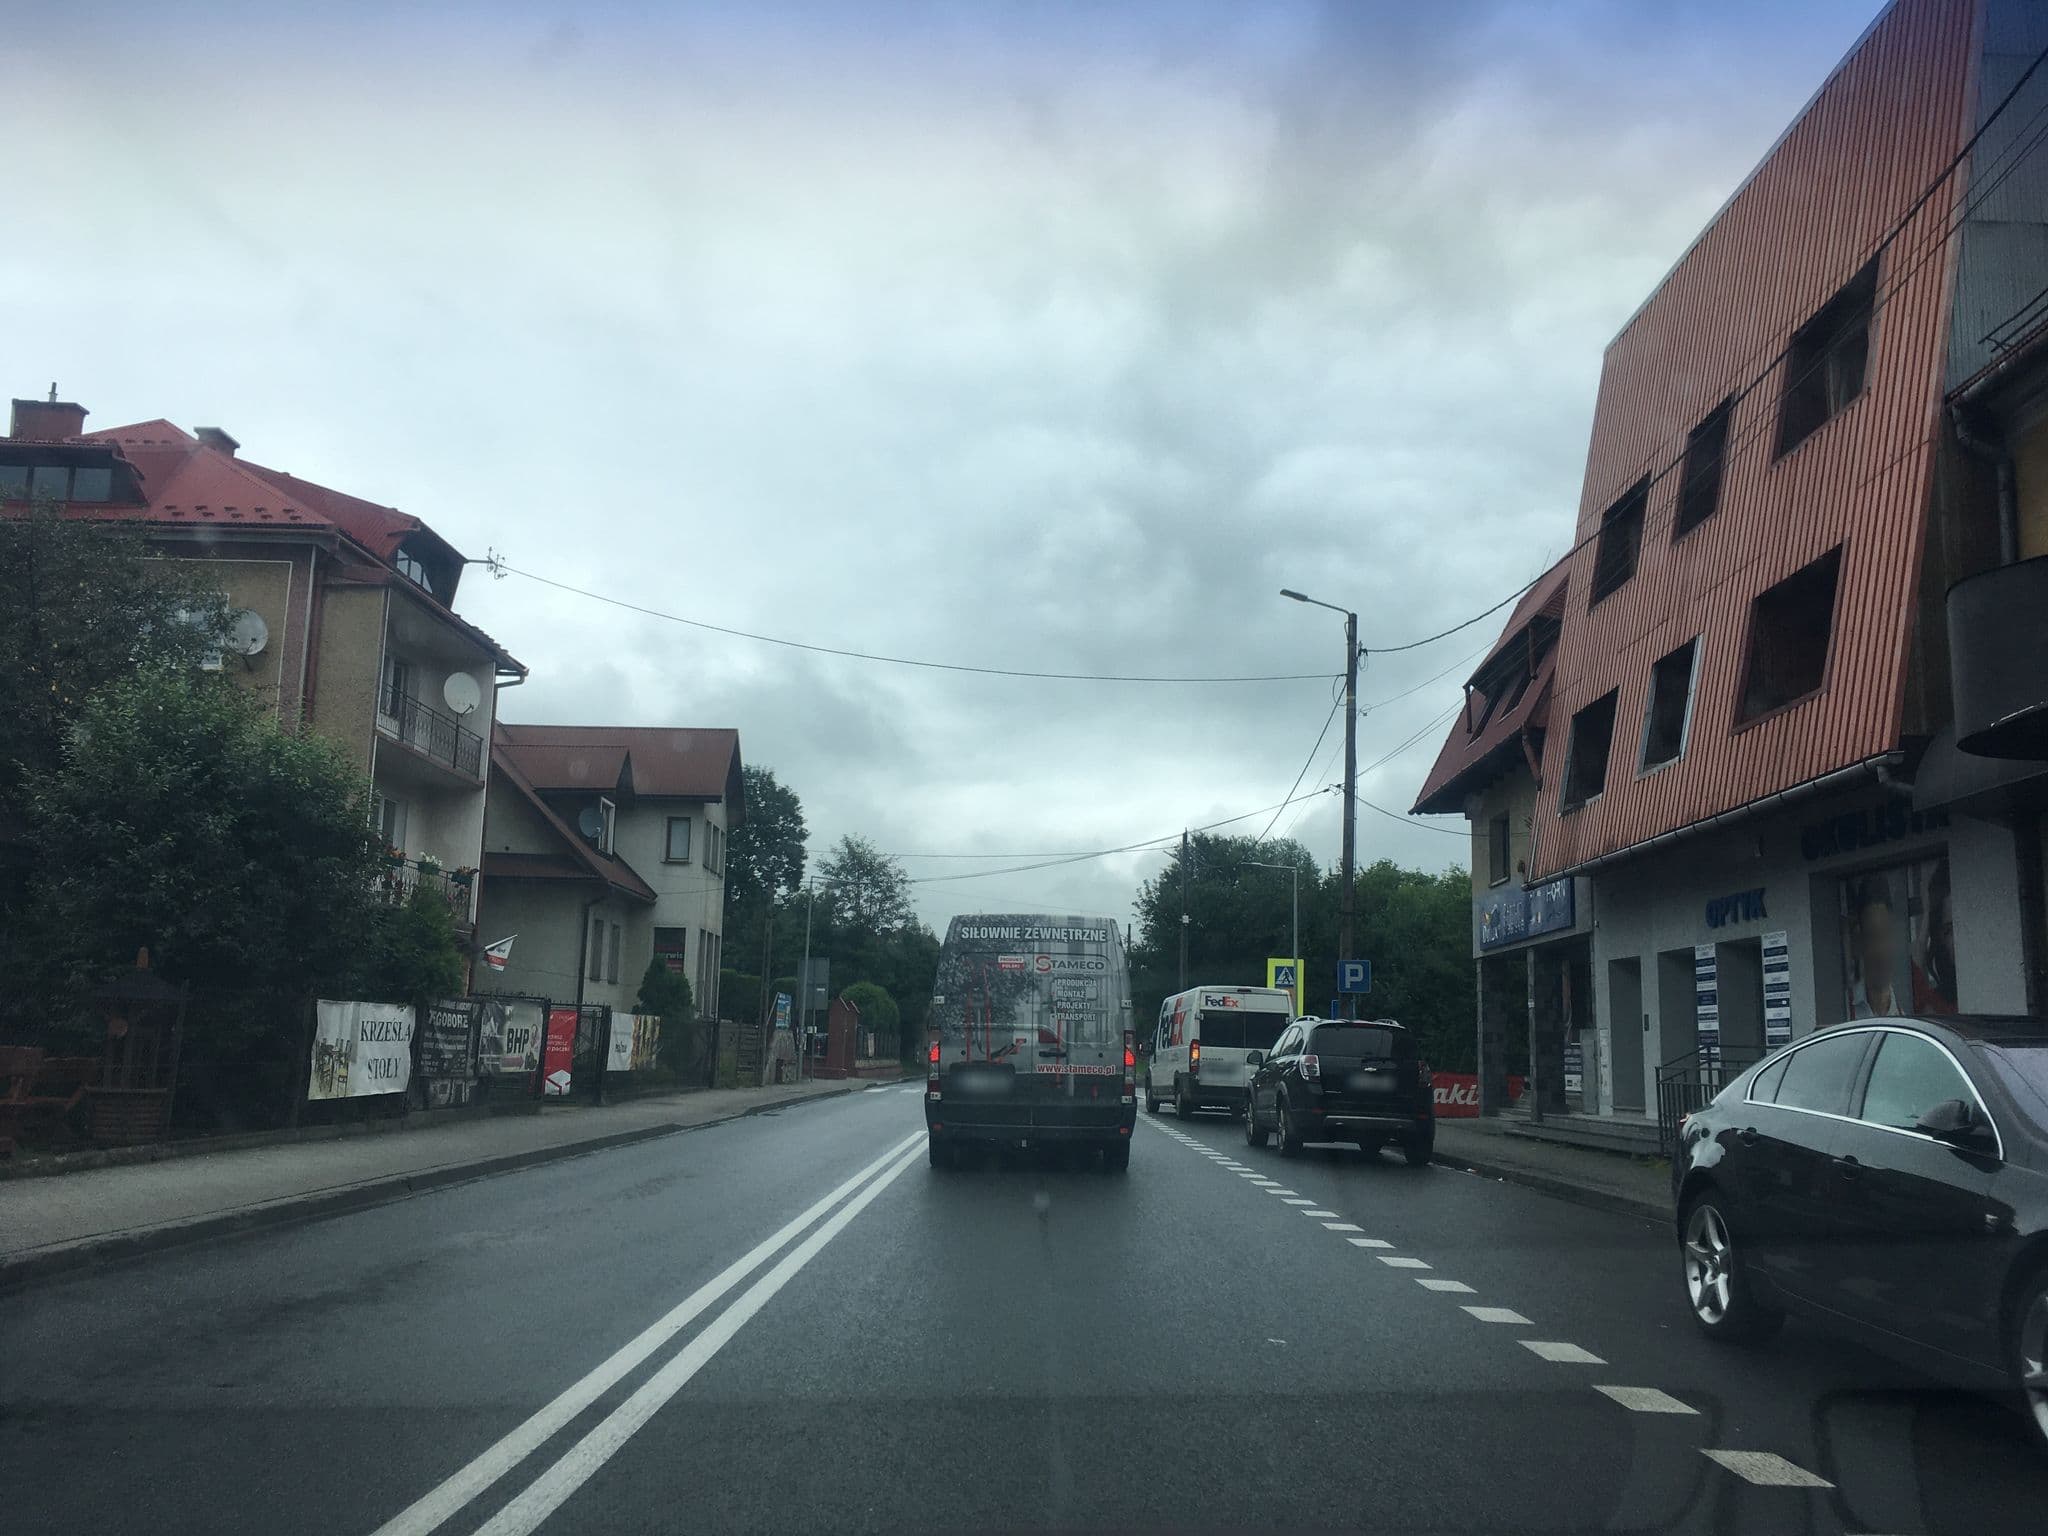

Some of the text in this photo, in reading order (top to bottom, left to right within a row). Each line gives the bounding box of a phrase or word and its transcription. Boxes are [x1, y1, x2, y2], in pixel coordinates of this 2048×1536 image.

[961, 926, 1106, 943] SIŁOWNIE ZEWNĘTRZNE
[1035, 955, 1105, 972] STAMECO
[1057, 978, 1097, 987] PRODUKCJA
[1344, 963, 1364, 989] P
[1057, 1001, 1090, 1010] PROJEKTY
[1205, 995, 1239, 1008] FedEx
[1057, 1012, 1097, 1021] TRANSPORT
[360, 1018, 412, 1042] KRZEŚŁA
[506, 1028, 530, 1054] BHP
[367, 1057, 402, 1080] STOŁY
[1036, 1063, 1116, 1076] www.stameco.pl
[1433, 1082, 1479, 1105] aki
